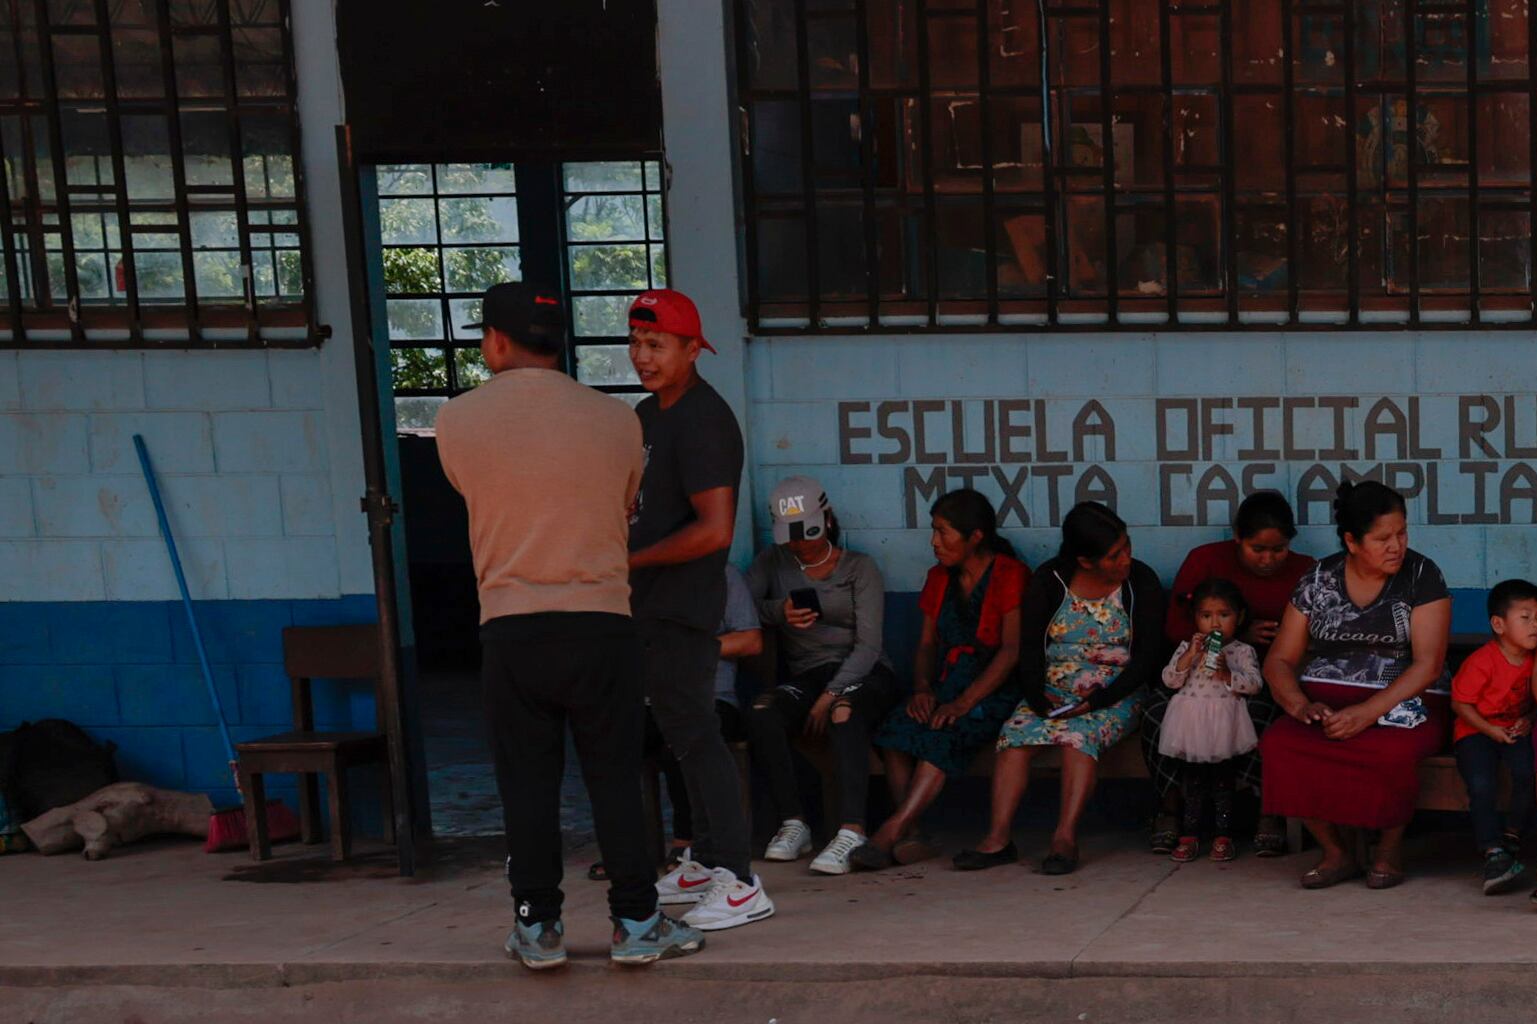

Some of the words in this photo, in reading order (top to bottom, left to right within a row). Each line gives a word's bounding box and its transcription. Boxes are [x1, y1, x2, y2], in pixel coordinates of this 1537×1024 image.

[838, 399, 1116, 464] ESCUELA
[1156, 396, 1441, 461] OFICIAL
[779, 495, 805, 516] CAT
[1310, 618, 1396, 644] Chicago
